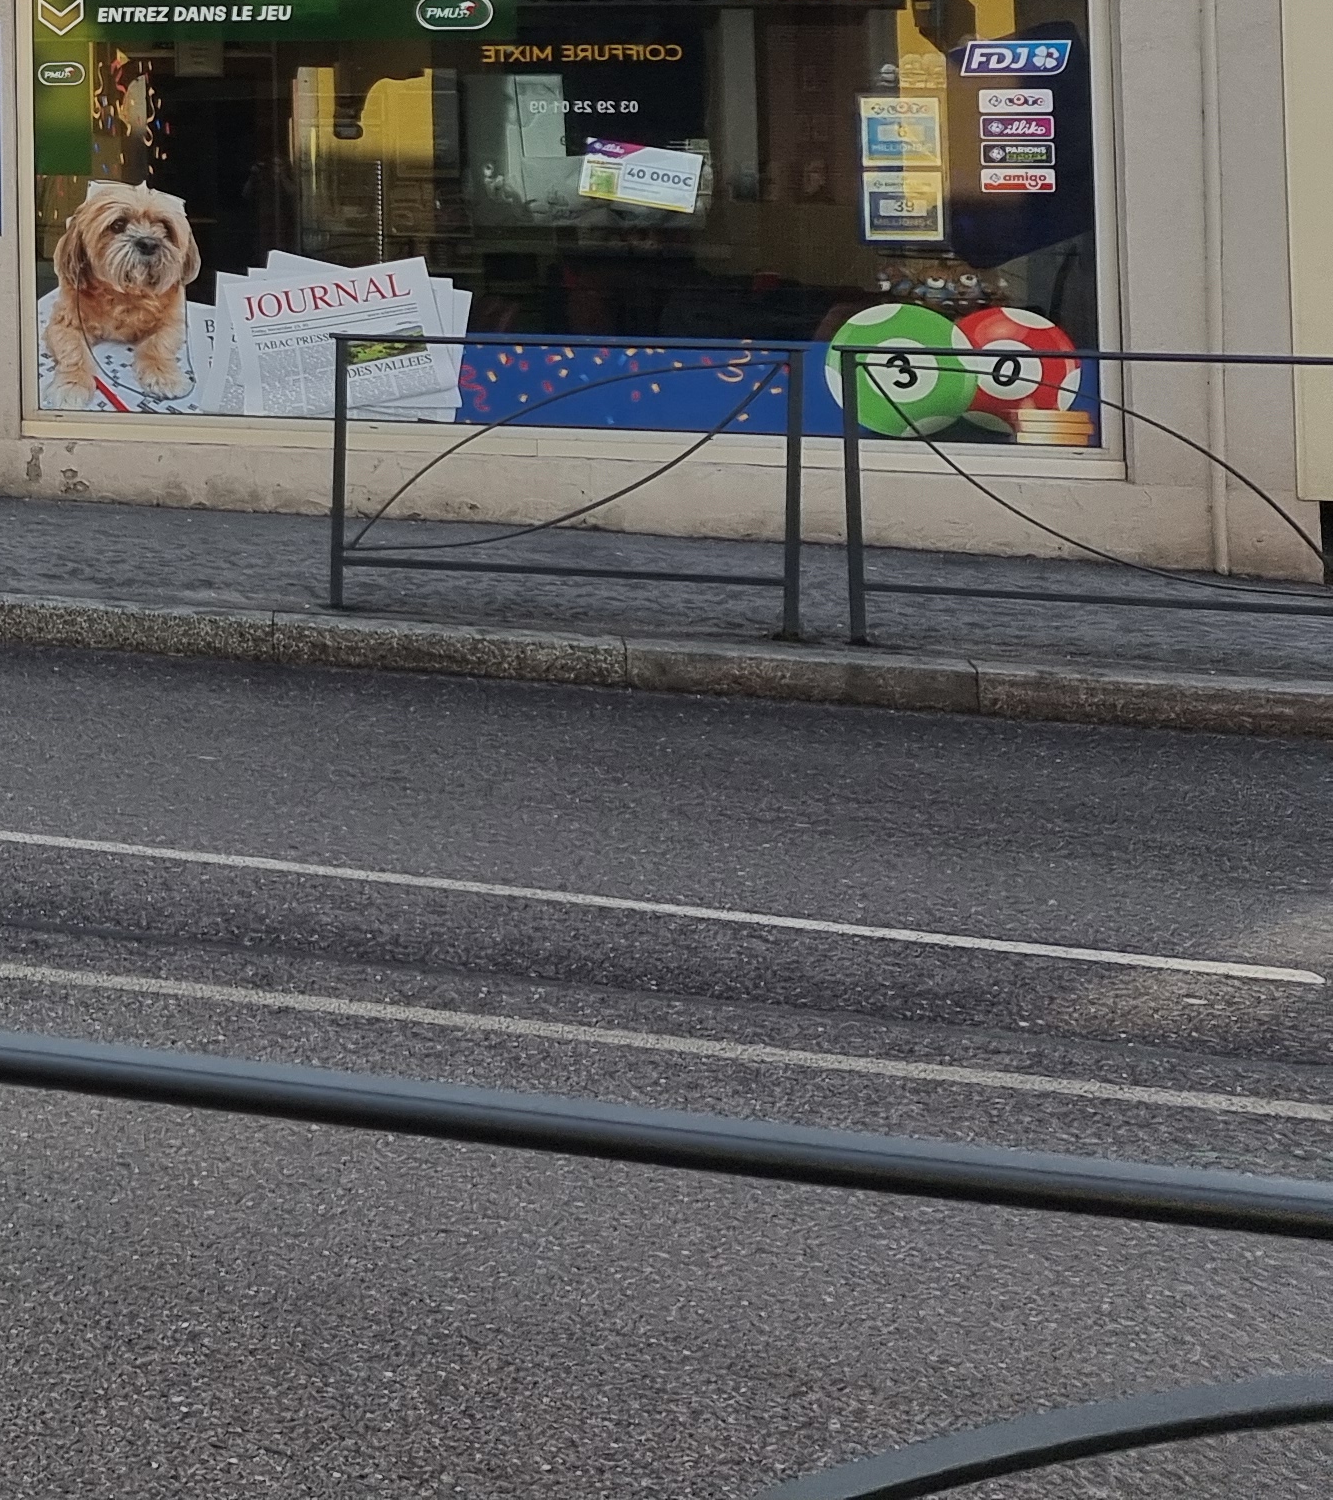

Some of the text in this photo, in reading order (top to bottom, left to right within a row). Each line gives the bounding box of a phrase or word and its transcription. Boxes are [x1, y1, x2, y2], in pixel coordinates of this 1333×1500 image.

[97, 4, 293, 23] ENTREZ DANS LE JEU
[425, 7, 460, 19] PMU
[970, 47, 1030, 69] FDJ
[42, 70, 67, 79] PMU
[1003, 119, 1046, 135] illiko
[1005, 146, 1047, 154] PARIONS
[627, 167, 693, 188] 40 000€
[1003, 171, 1048, 187] amigo
[894, 200, 915, 213] 39
[243, 272, 411, 321] JOURNAL
[255, 332, 334, 351] TABAC PRESS
[347, 354, 433, 378] DES VALLEES
[886, 354, 919, 389] 3
